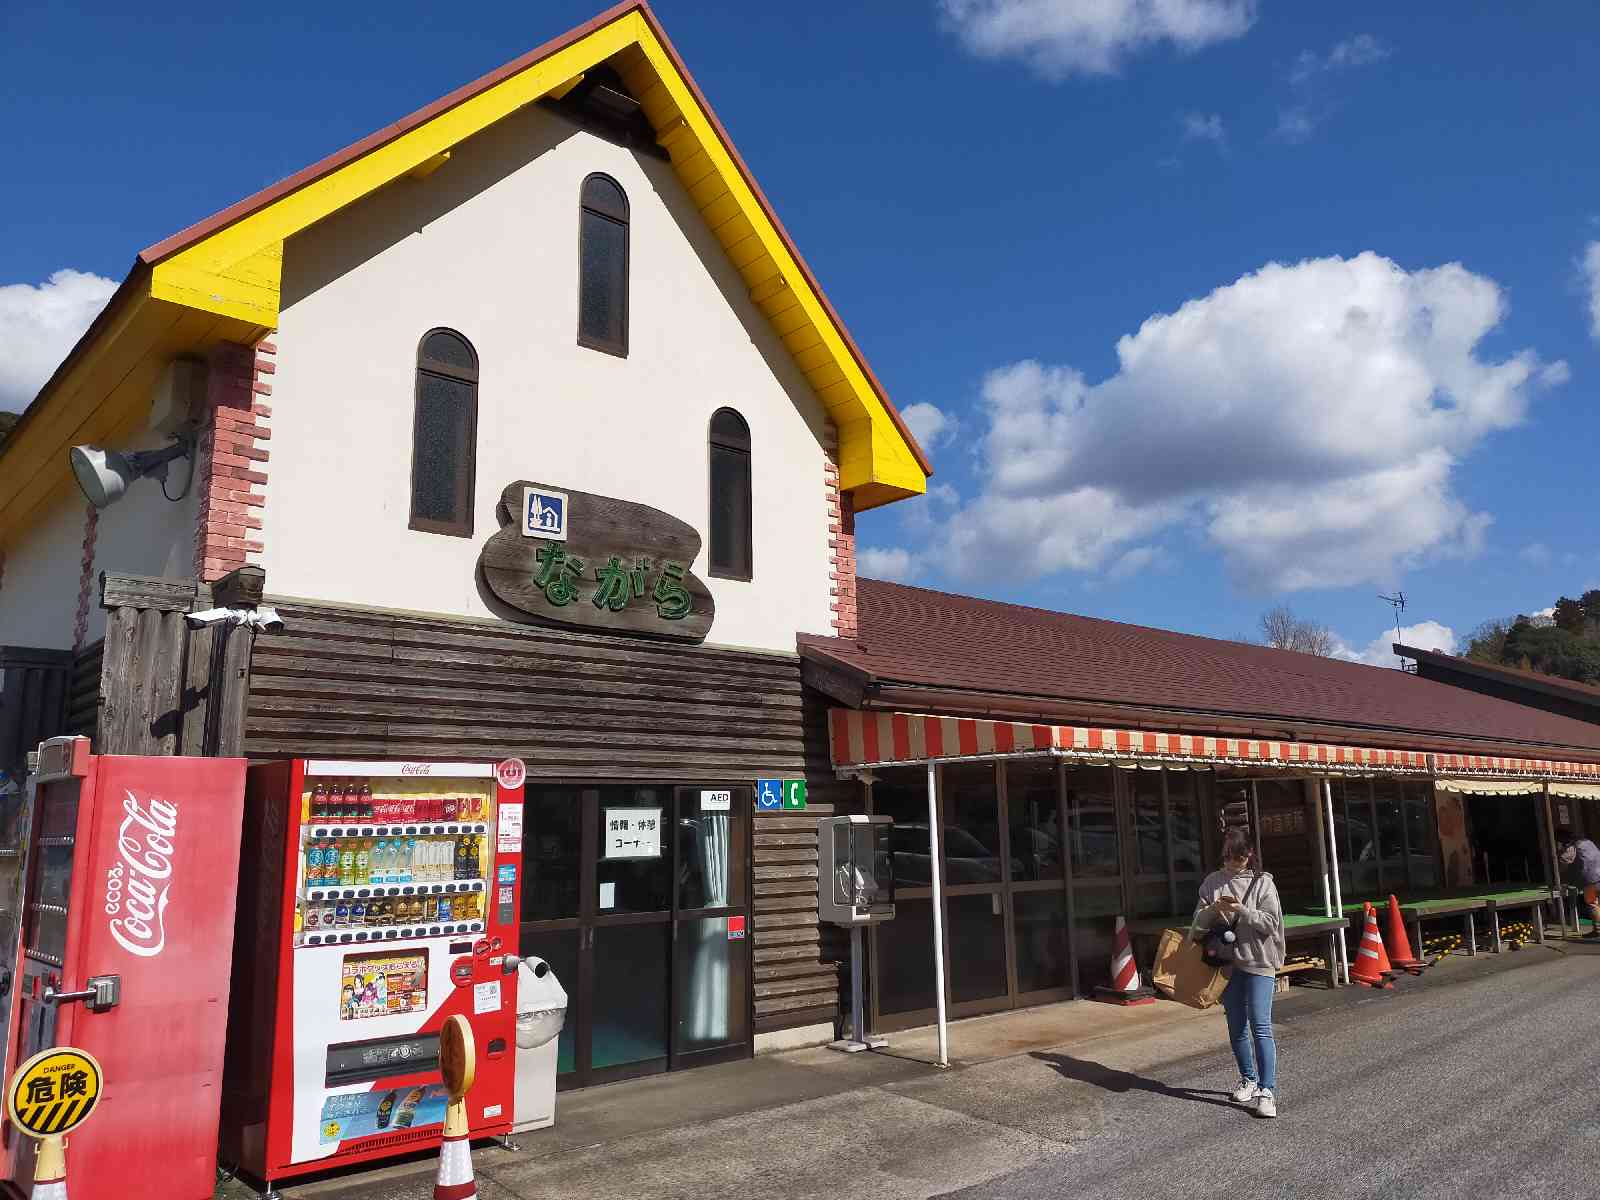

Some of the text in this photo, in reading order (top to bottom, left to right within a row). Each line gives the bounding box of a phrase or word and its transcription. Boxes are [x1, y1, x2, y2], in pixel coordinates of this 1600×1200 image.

[533, 541, 693, 620] ながら
[710, 793, 729, 802] AED
[109, 790, 178, 957] Coca-Cola
[43, 1063, 76, 1073] DANGER
[26, 1069, 89, 1104] 危険
